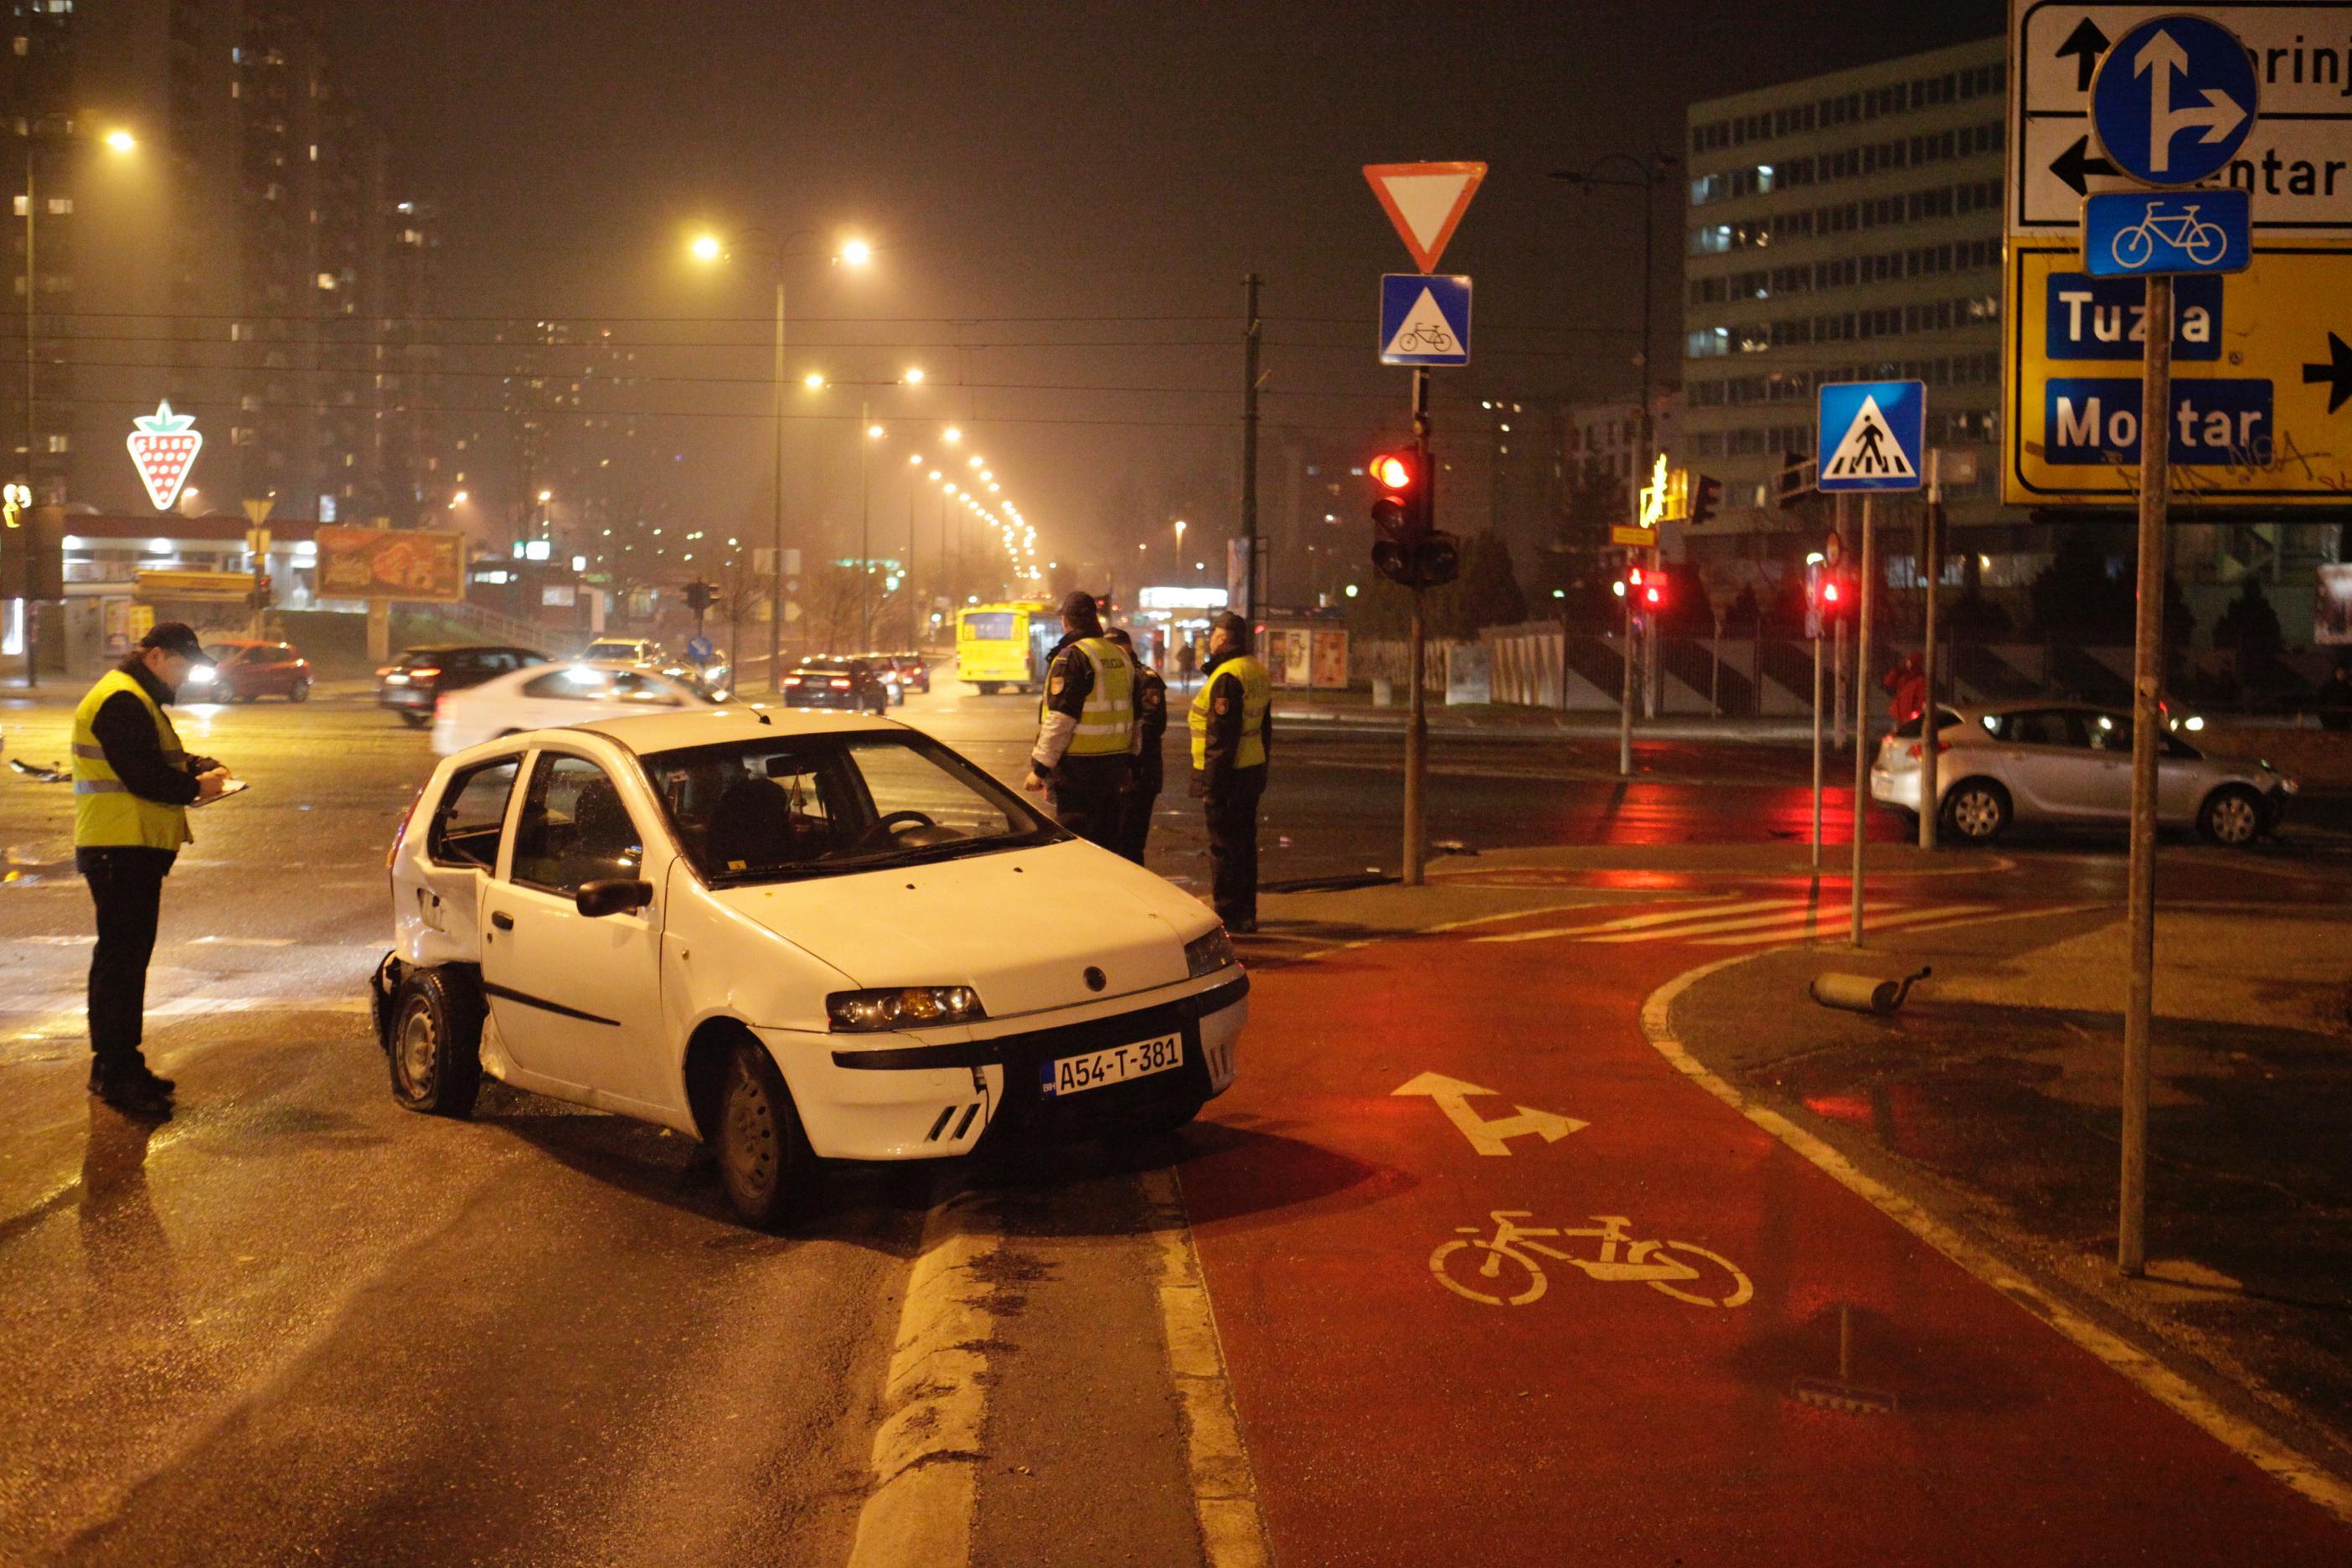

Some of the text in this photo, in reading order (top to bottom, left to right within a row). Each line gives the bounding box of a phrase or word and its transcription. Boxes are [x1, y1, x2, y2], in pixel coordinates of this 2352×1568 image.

[2195, 148, 2346, 195] ntar
[2056, 396, 2262, 447] Motar
[1060, 1038, 1179, 1091] A54-T-381
